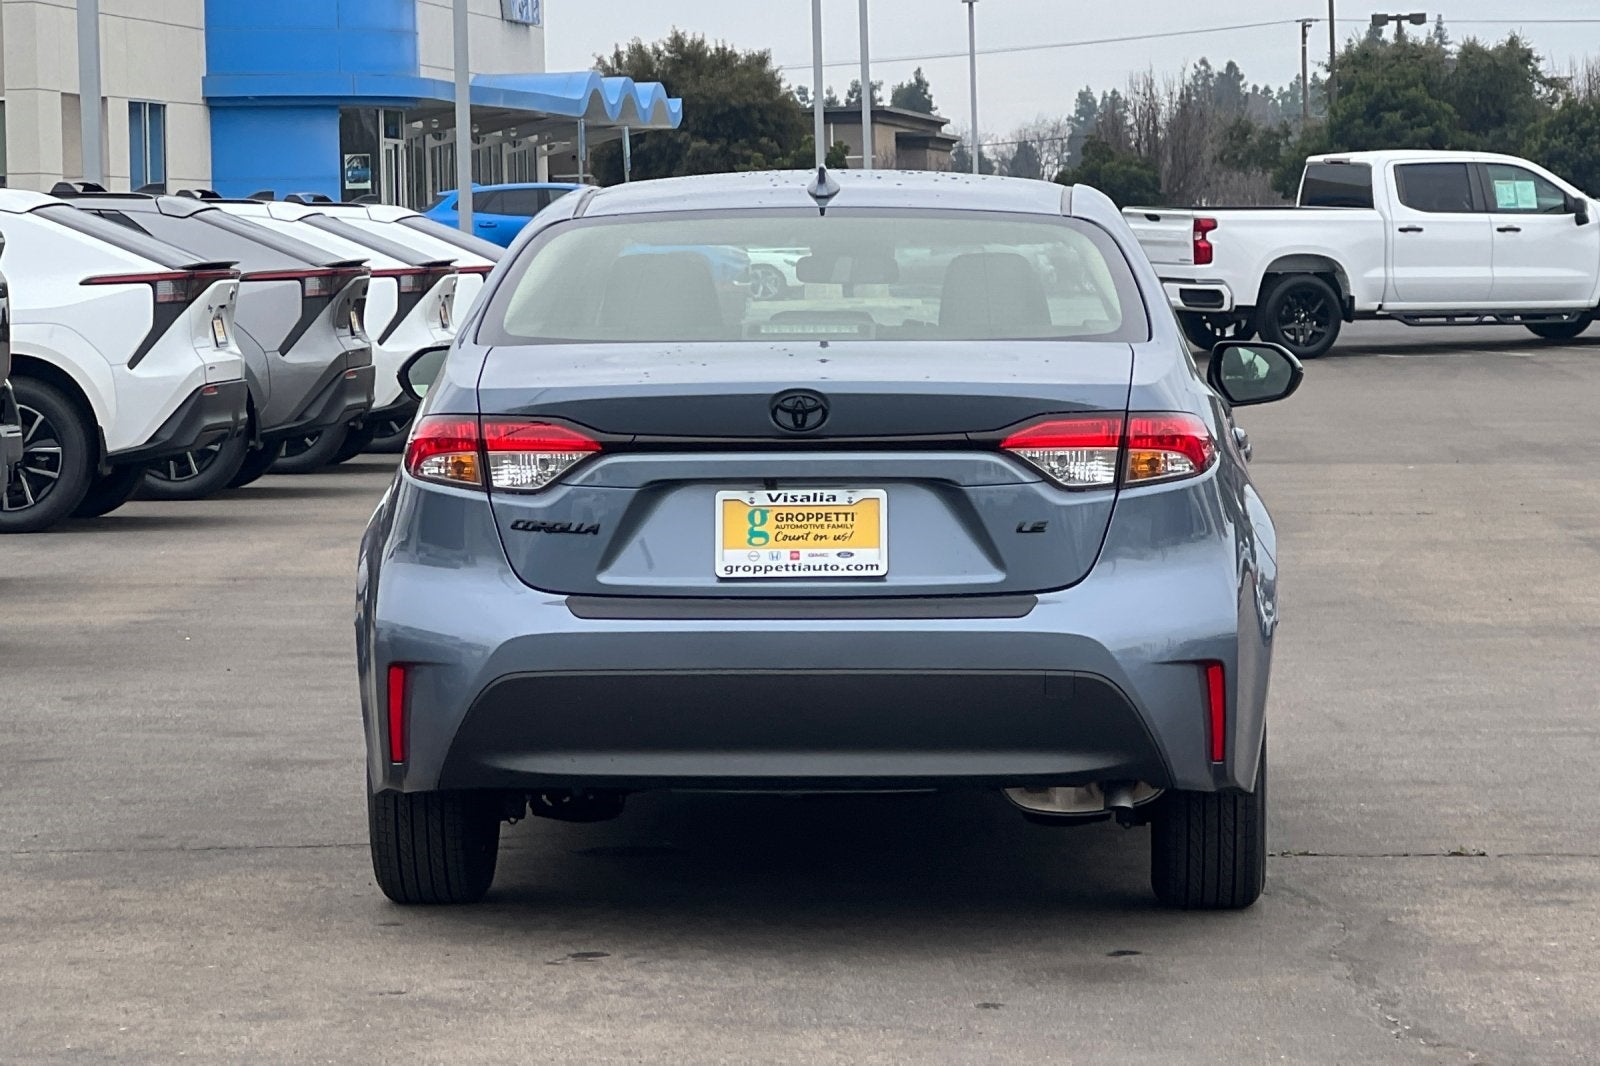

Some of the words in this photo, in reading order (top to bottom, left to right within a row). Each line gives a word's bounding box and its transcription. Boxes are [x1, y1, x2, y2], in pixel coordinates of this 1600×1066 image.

[767, 492, 837, 503] Visalia
[775, 512, 855, 522] GROPPETTI
[511, 520, 600, 535] COROLLA
[747, 508, 770, 547] g
[1016, 520, 1048, 533] LE
[775, 531, 809, 542] Count
[813, 533, 829, 541] on
[833, 531, 855, 541] us!
[724, 562, 880, 575] groppettiauto.com
